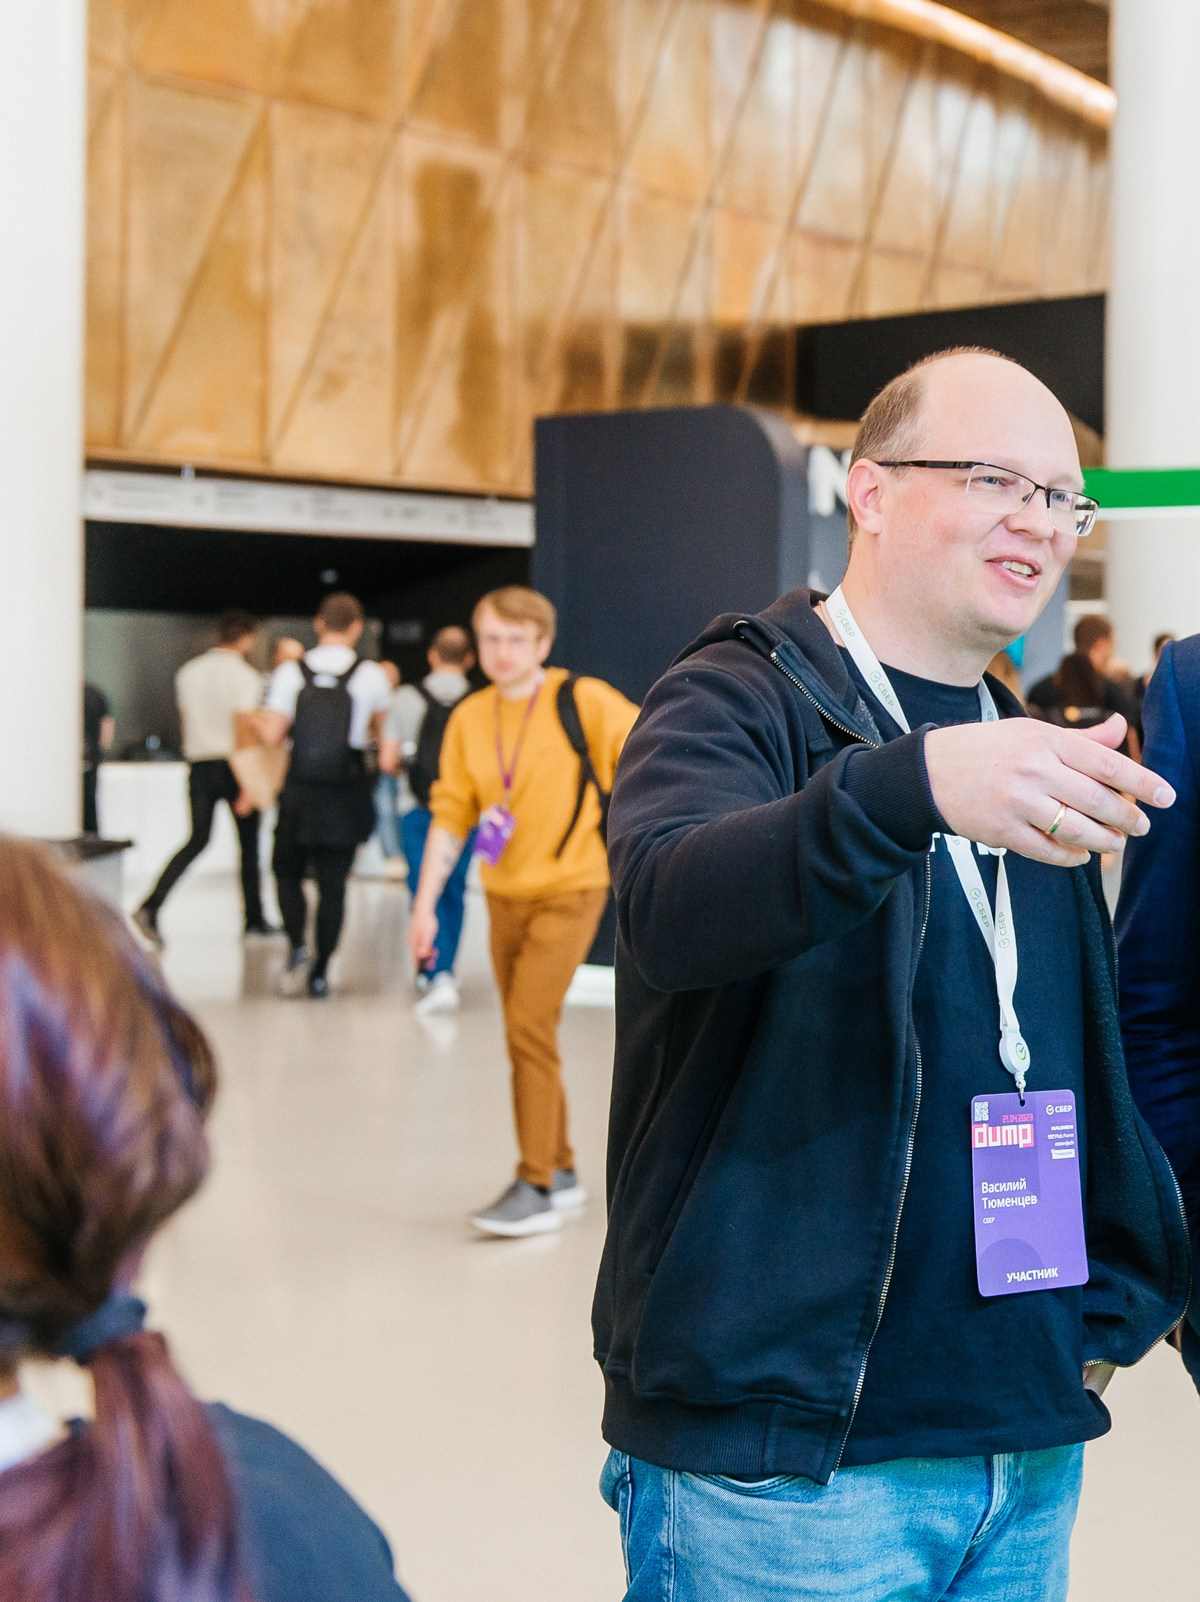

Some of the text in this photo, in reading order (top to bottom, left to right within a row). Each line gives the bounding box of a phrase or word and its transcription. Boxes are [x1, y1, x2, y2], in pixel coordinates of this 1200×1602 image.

[840, 617, 856, 638] СБЕР
[878, 683, 895, 707] СБЕР
[976, 902, 990, 928] СБЕР
[999, 912, 1007, 936] СБЕР
[1055, 1105, 1073, 1113] СБЕР
[974, 1123, 1033, 1148] dump
[981, 1178, 1027, 1194] Василий
[981, 1195, 1038, 1210] Тюменцев
[982, 1216, 996, 1224] СБЕР
[1006, 1267, 1059, 1283] УЧАСТНИК
